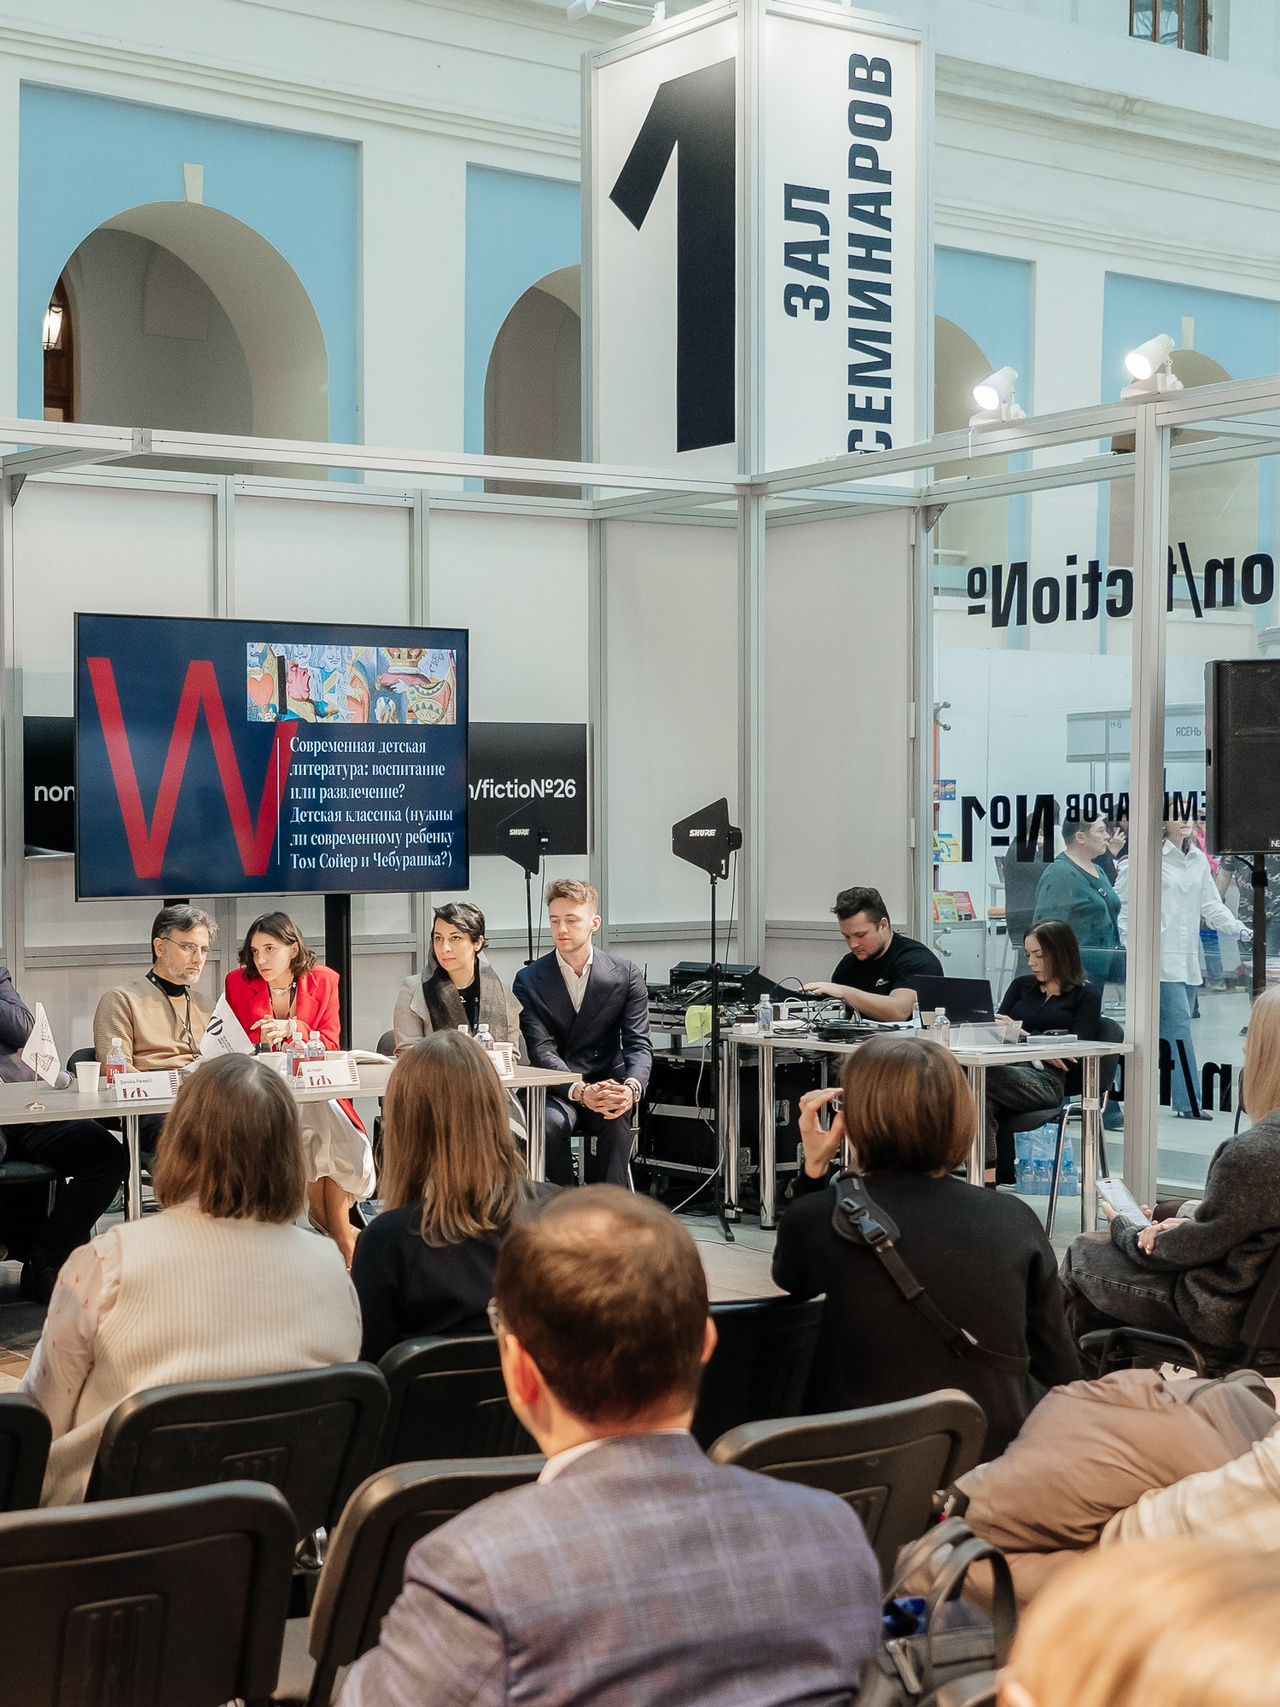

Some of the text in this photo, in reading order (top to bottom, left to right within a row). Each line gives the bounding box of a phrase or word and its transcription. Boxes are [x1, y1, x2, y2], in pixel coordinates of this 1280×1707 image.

[609, 57, 735, 453] 1
[784, 183, 830, 321] ЗАЛ
[847, 53, 892, 454] СЕМИНАРОВ
[290, 737, 426, 756] Современная детская
[289, 764, 445, 780] литература: воспитание
[290, 783, 406, 803] или развлечение?
[290, 806, 453, 825] Детская классика (нужны
[290, 827, 455, 849] ли современному ребенку
[689, 829, 717, 837] SHURE
[290, 851, 452, 872] Том Сойер и Чебурашка?)
